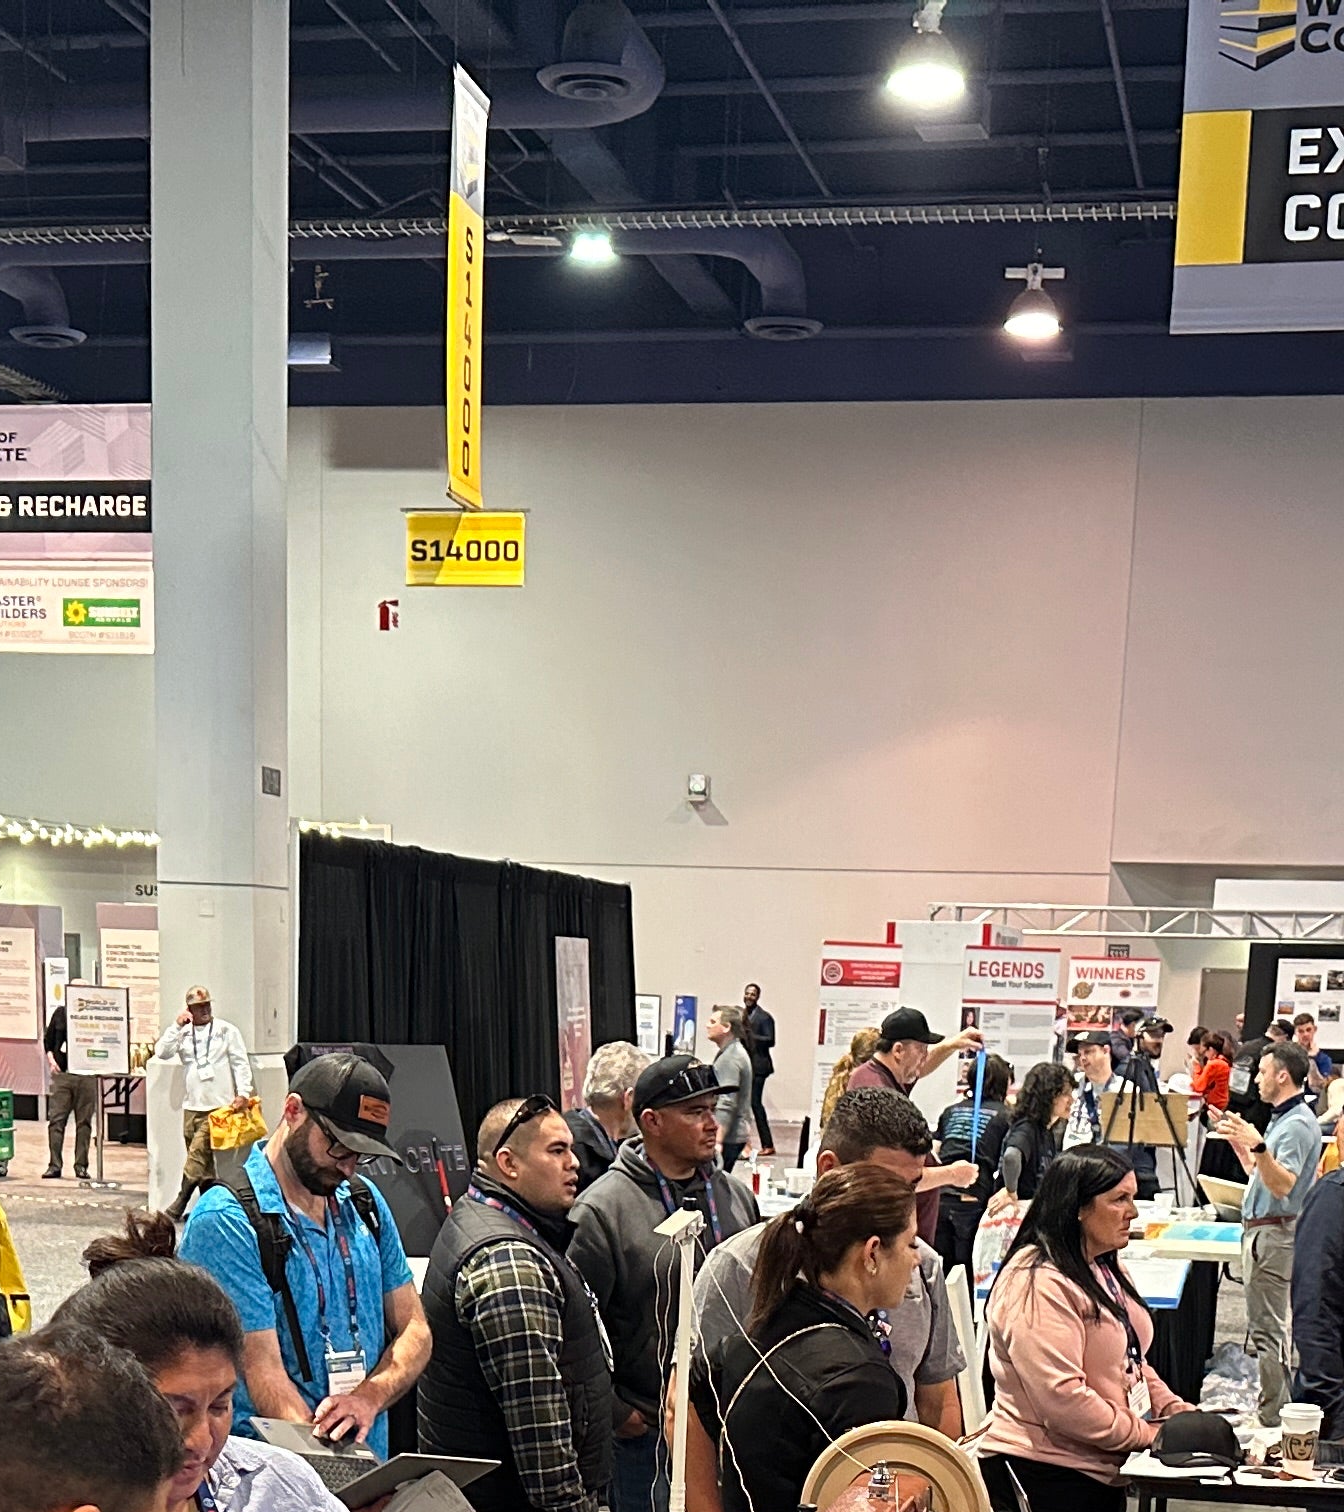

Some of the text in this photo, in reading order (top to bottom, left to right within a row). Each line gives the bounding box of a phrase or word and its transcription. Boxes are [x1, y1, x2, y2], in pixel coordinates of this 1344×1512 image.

[461, 225, 474, 477] S14000
[18, 495, 147, 517] RECHARGE
[410, 538, 520, 563] S14000
[52, 578, 90, 588] LOUNGE
[968, 960, 1046, 979] LEGENDS
[1075, 966, 1146, 981] WINNERS
[1009, 980, 1023, 988] Your
[1024, 981, 1054, 990] Speakers
